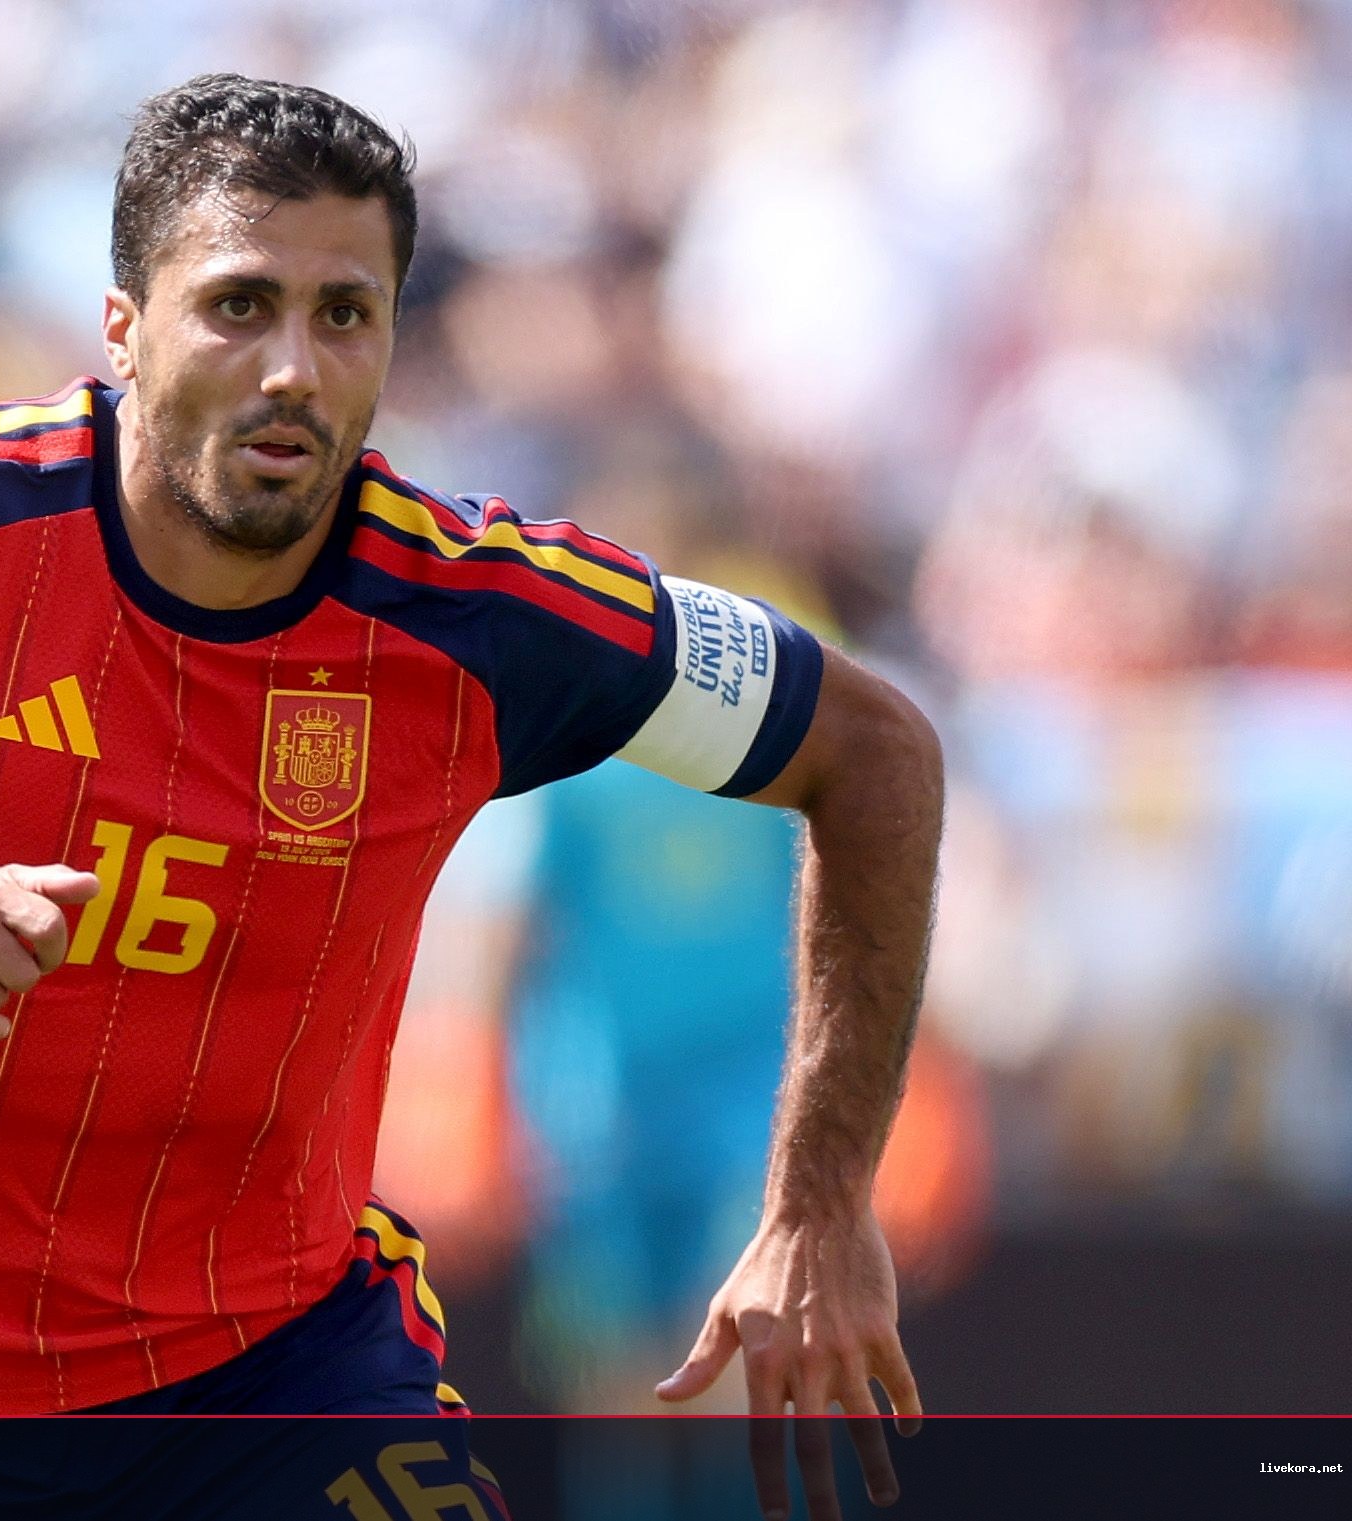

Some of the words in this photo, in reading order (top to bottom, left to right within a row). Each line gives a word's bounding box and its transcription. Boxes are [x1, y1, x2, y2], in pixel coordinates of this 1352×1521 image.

[671, 587, 700, 684] FOOTBALL
[688, 589, 723, 692] UNITES
[753, 626, 766, 673] FIFA
[721, 661, 744, 708] the
[65, 819, 229, 974] 16
[324, 1440, 491, 1521] 16
